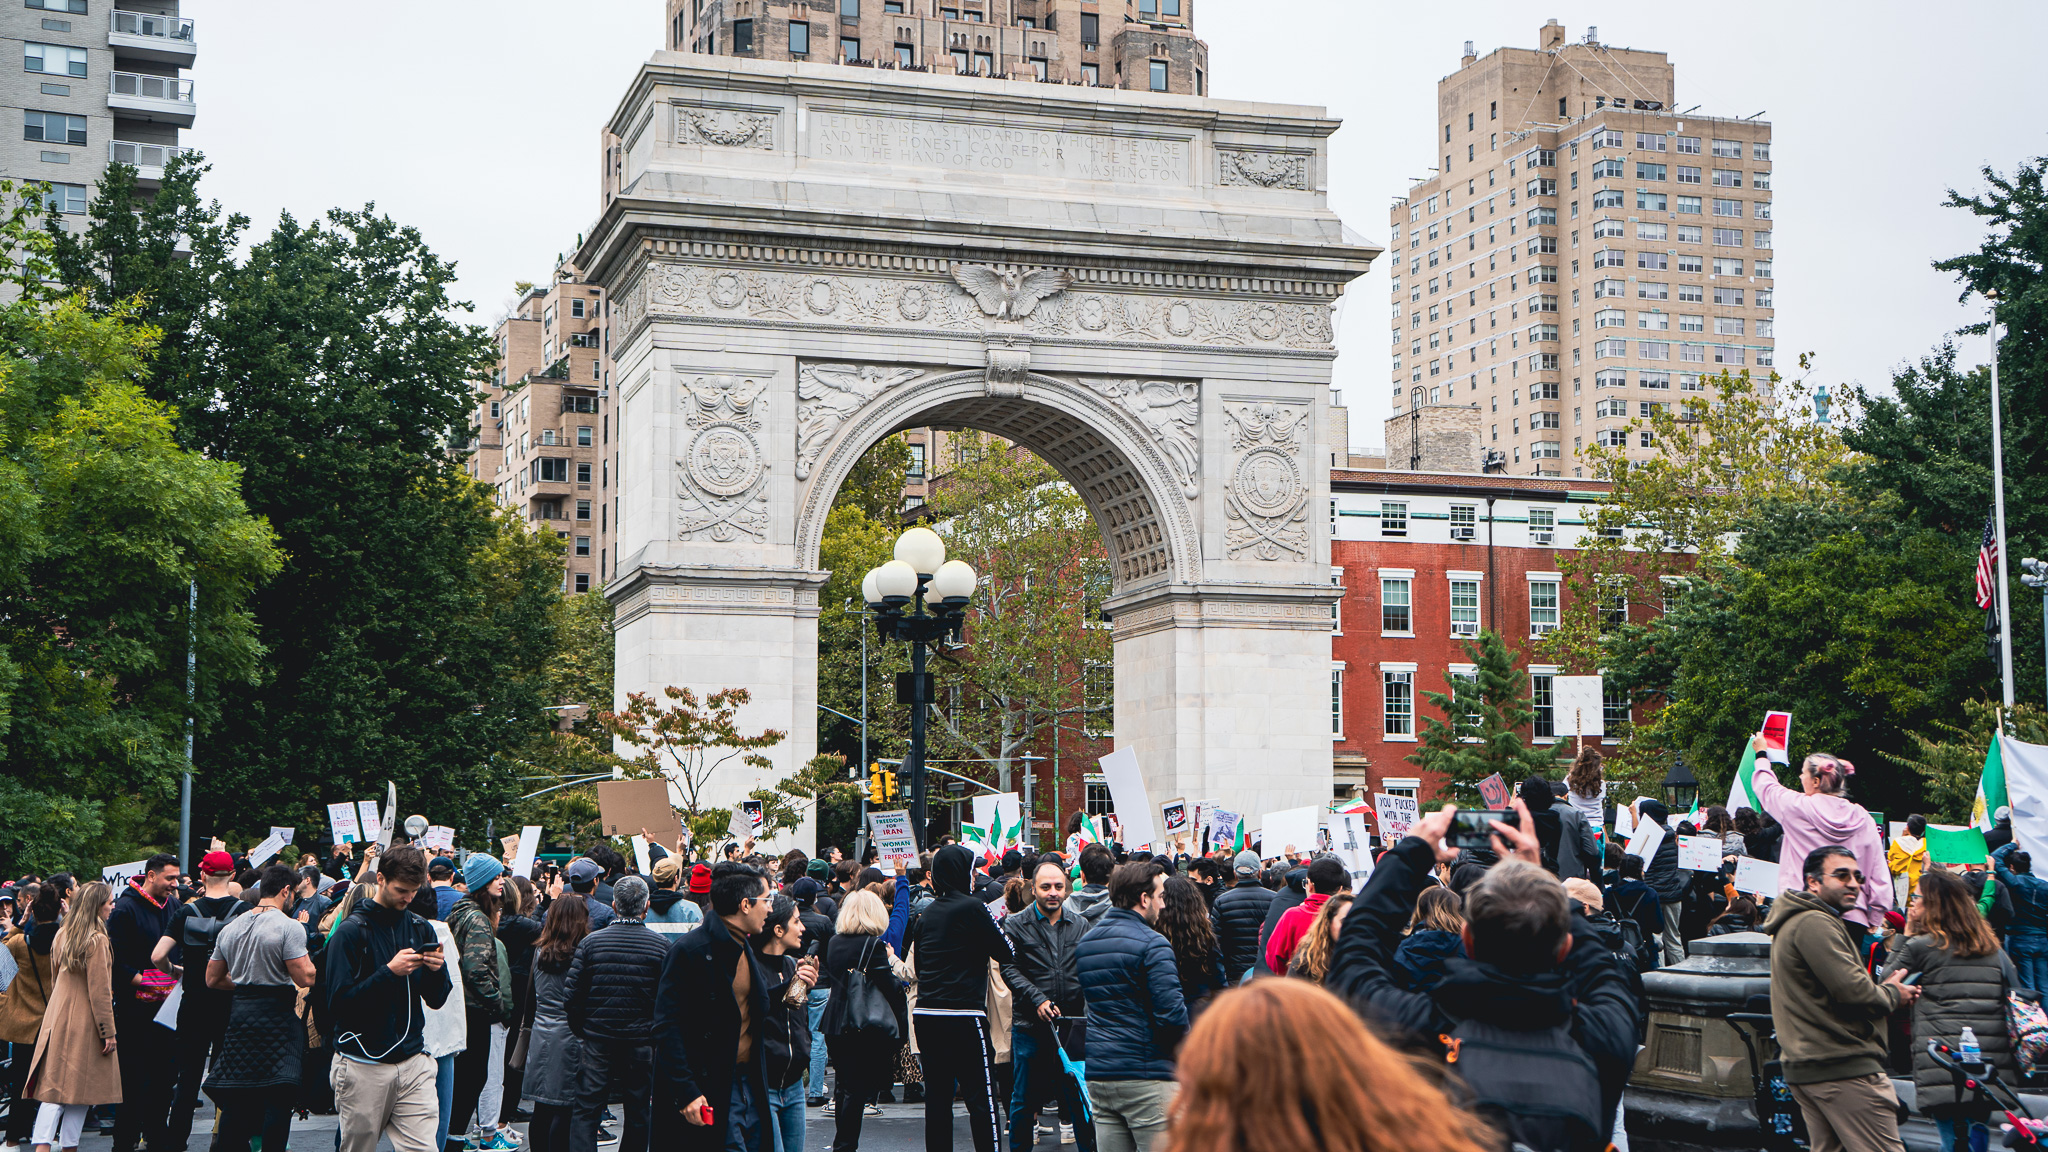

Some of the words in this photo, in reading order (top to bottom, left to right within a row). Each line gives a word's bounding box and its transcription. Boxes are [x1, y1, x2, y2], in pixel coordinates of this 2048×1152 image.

[820, 116, 849, 128] LET
[854, 117, 871, 130] US
[877, 120, 920, 135] RAISE
[927, 125, 936, 136] A
[943, 126, 1024, 143] STANDARD
[1030, 133, 1049, 145] TO
[1055, 135, 1105, 149] WHICH
[1109, 139, 1139, 153] THE
[1145, 142, 1180, 155] WISE
[820, 130, 850, 143] AND
[858, 132, 889, 146] THE
[899, 136, 962, 151] HONEST
[971, 142, 1004, 154] CAN
[1012, 144, 1064, 160] REPAIR
[1091, 151, 1120, 164] THE
[1129, 153, 1180, 168] EVENT
[820, 143, 832, 155] IS
[839, 145, 853, 157] IN
[861, 146, 892, 160] THE
[901, 149, 945, 164] HAND
[953, 154, 972, 166] OF
[980, 156, 1013, 169] GOD
[1078, 163, 1180, 181] WASHINGTON
[1379, 797, 1391, 808] YOU
[1394, 799, 1416, 811] FUCKED
[333, 819, 357, 828] FREEDOM
[1383, 810, 1398, 820] WITH
[1400, 811, 1412, 823] THE
[1390, 821, 1411, 832] WRONG
